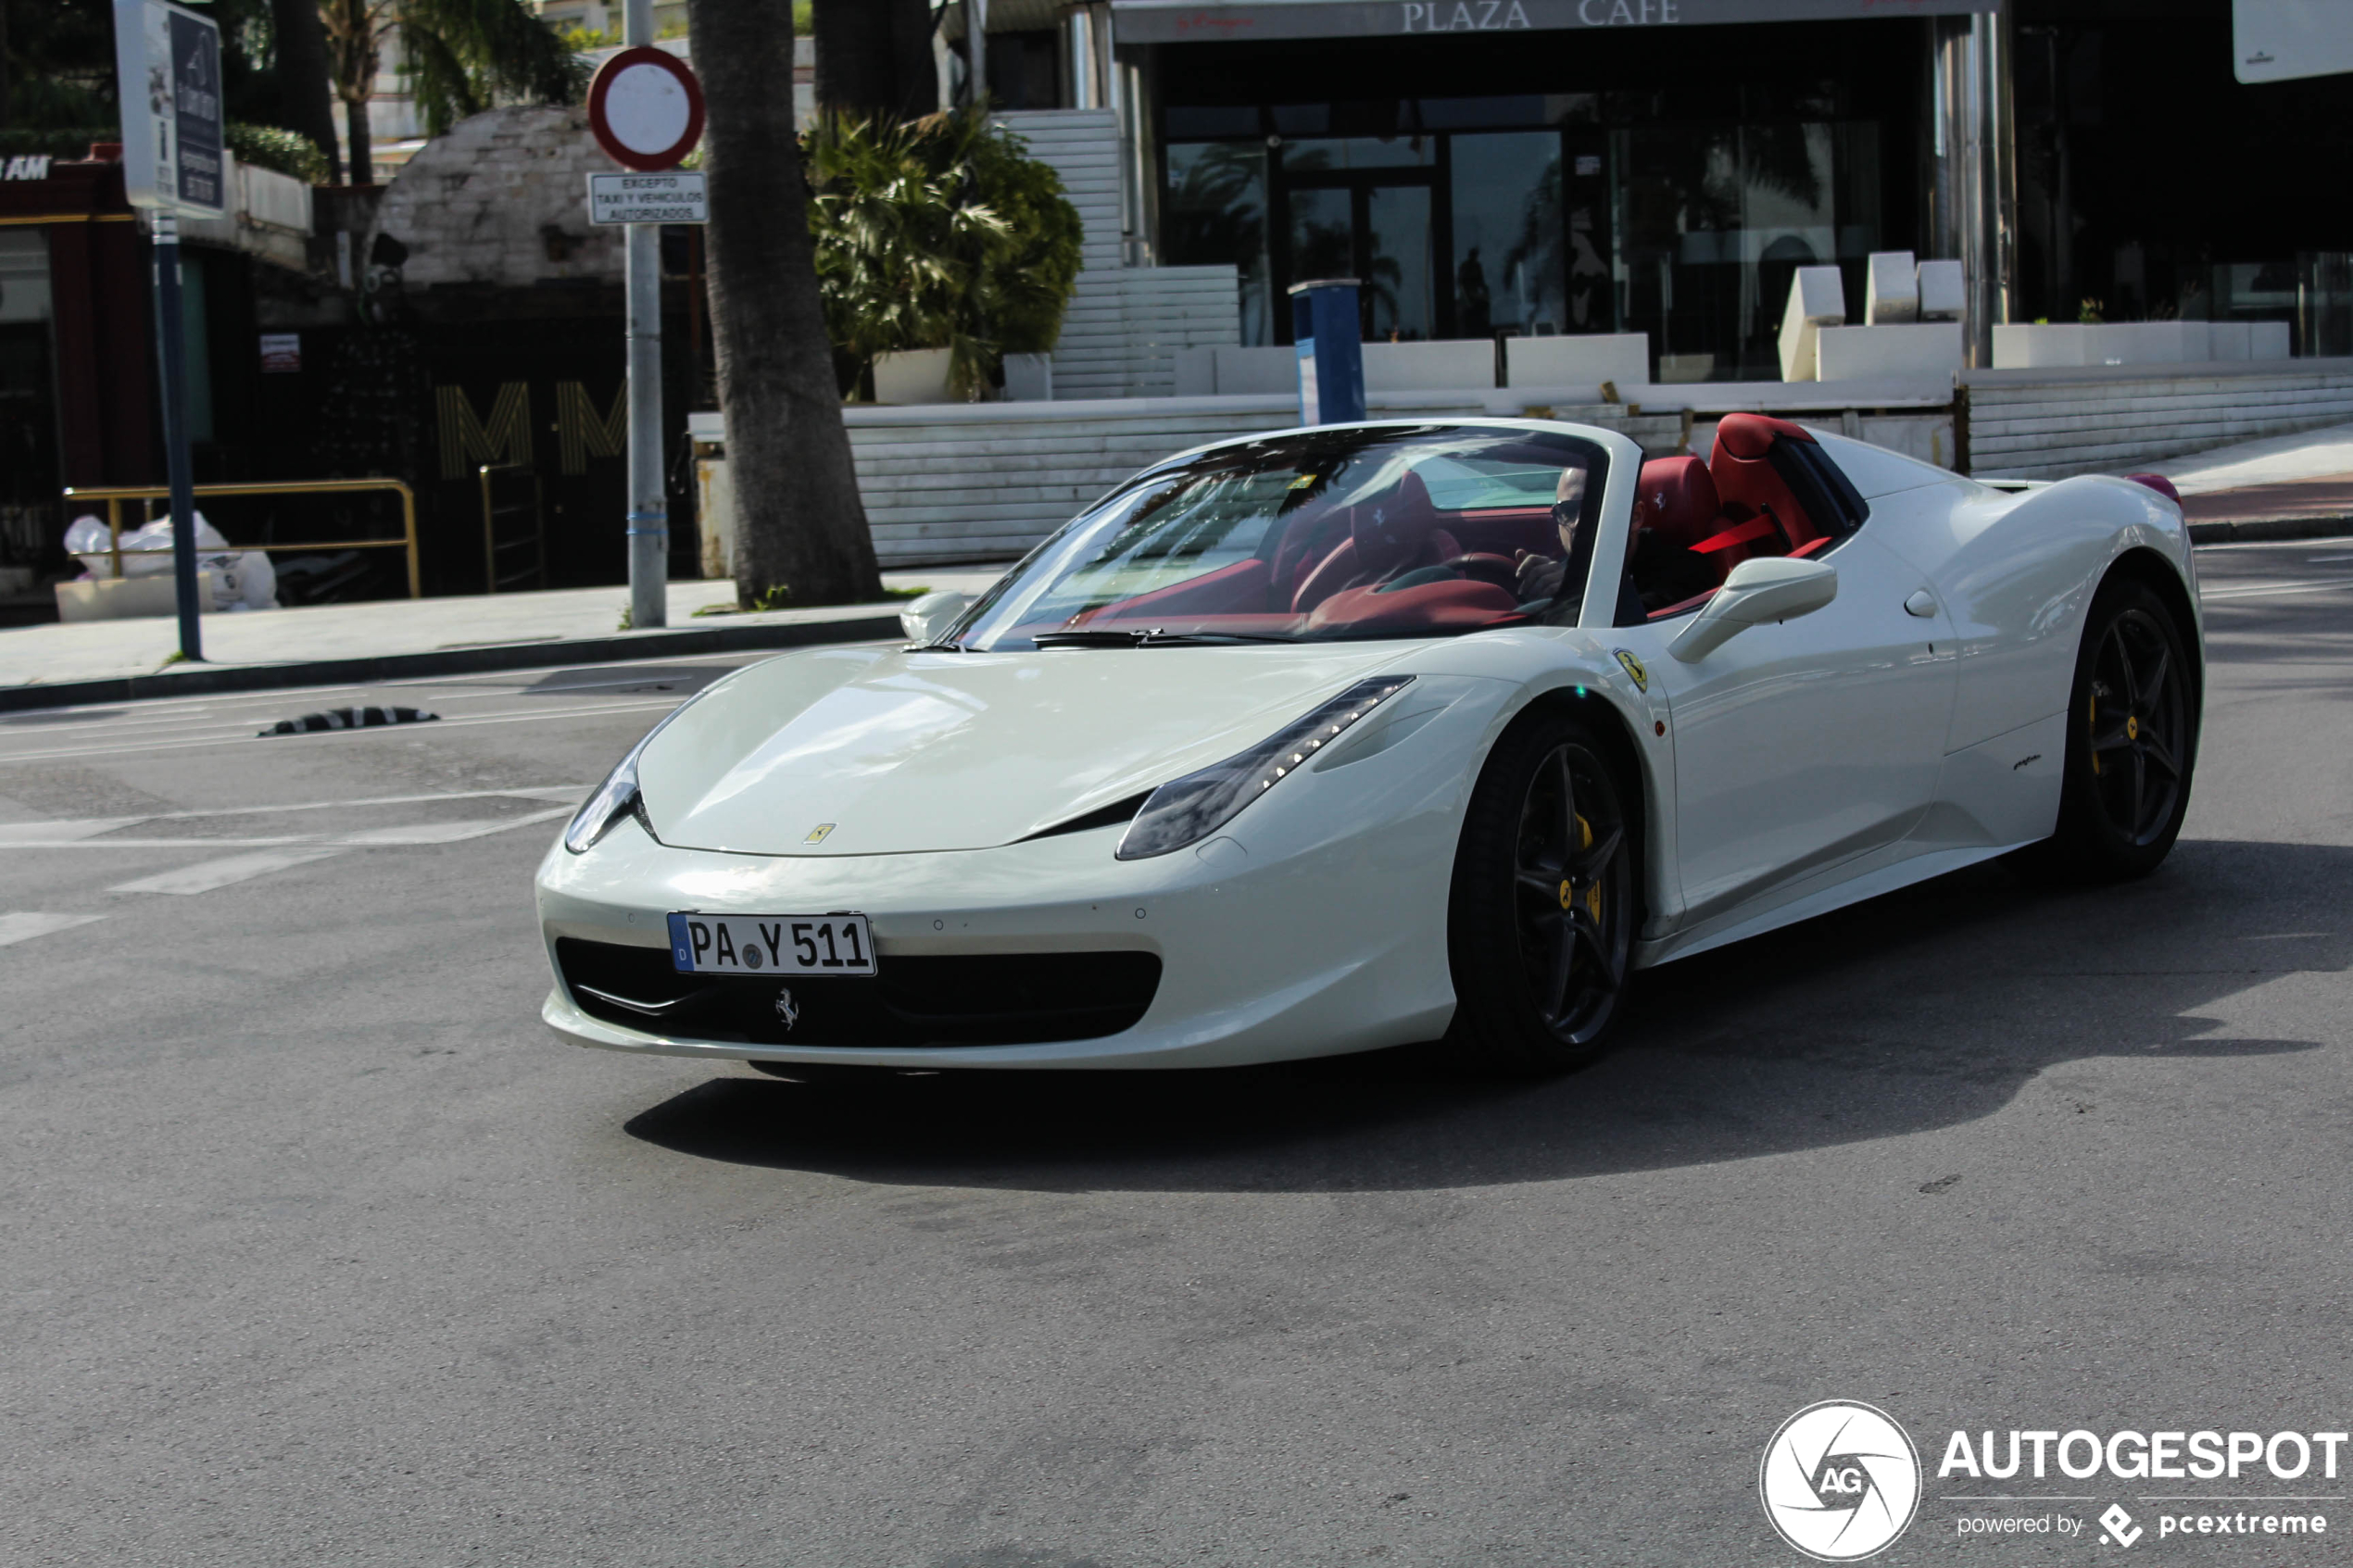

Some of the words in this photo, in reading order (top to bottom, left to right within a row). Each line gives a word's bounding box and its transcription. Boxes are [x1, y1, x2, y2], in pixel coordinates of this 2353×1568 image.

[1400, 0, 1531, 32] PLAZA
[623, 178, 677, 189] EXCEPTO
[598, 194, 623, 204] TAXI
[627, 194, 635, 203] Y
[639, 193, 703, 204] VEHICULOS
[610, 208, 694, 220] AUTORIZADOS
[688, 922, 738, 966] PA
[759, 923, 781, 967] Y
[791, 923, 869, 967] 511
